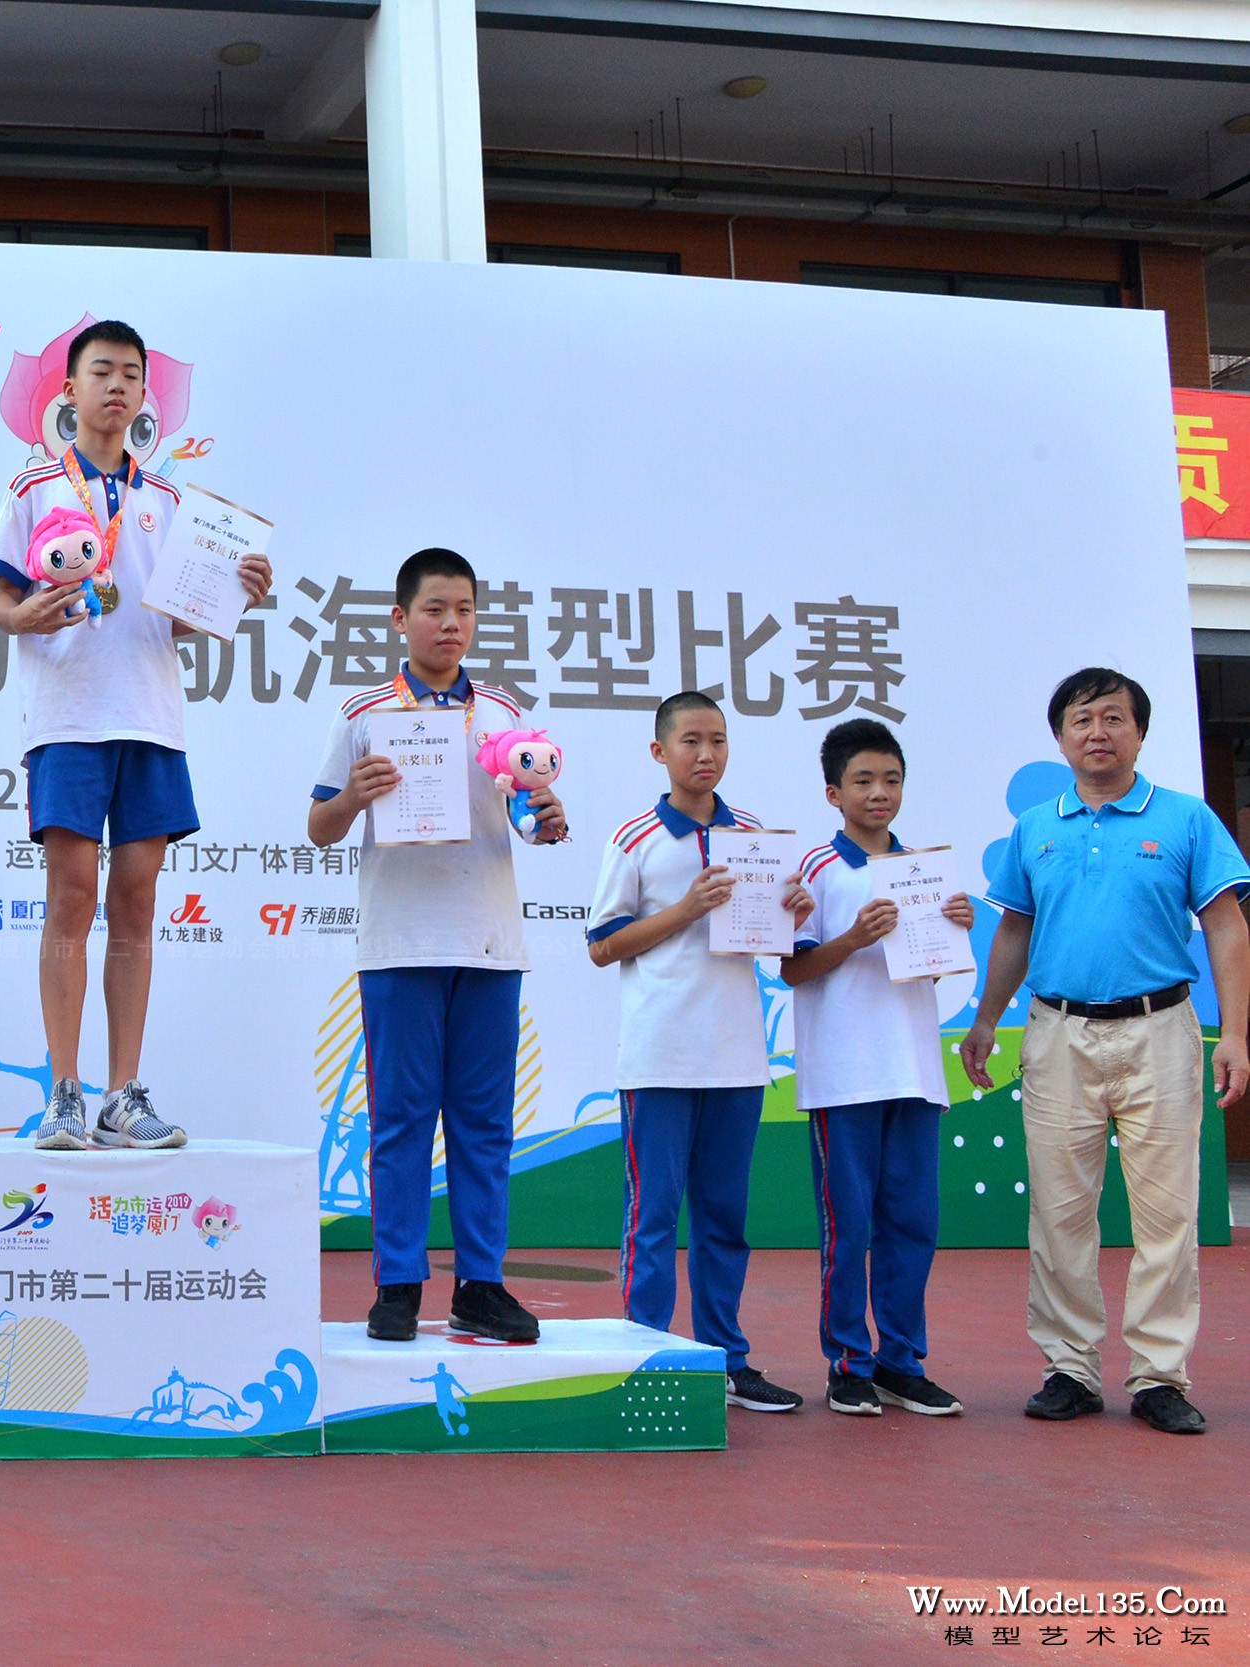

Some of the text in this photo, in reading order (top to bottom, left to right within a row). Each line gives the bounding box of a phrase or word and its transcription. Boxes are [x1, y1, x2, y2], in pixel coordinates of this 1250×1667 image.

[160, 842, 359, 875] 门文广体育有
[159, 926, 223, 942] 九龙建设
[89, 1195, 189, 1221] 活力市运 2019
[111, 1213, 181, 1236] 追梦厦门
